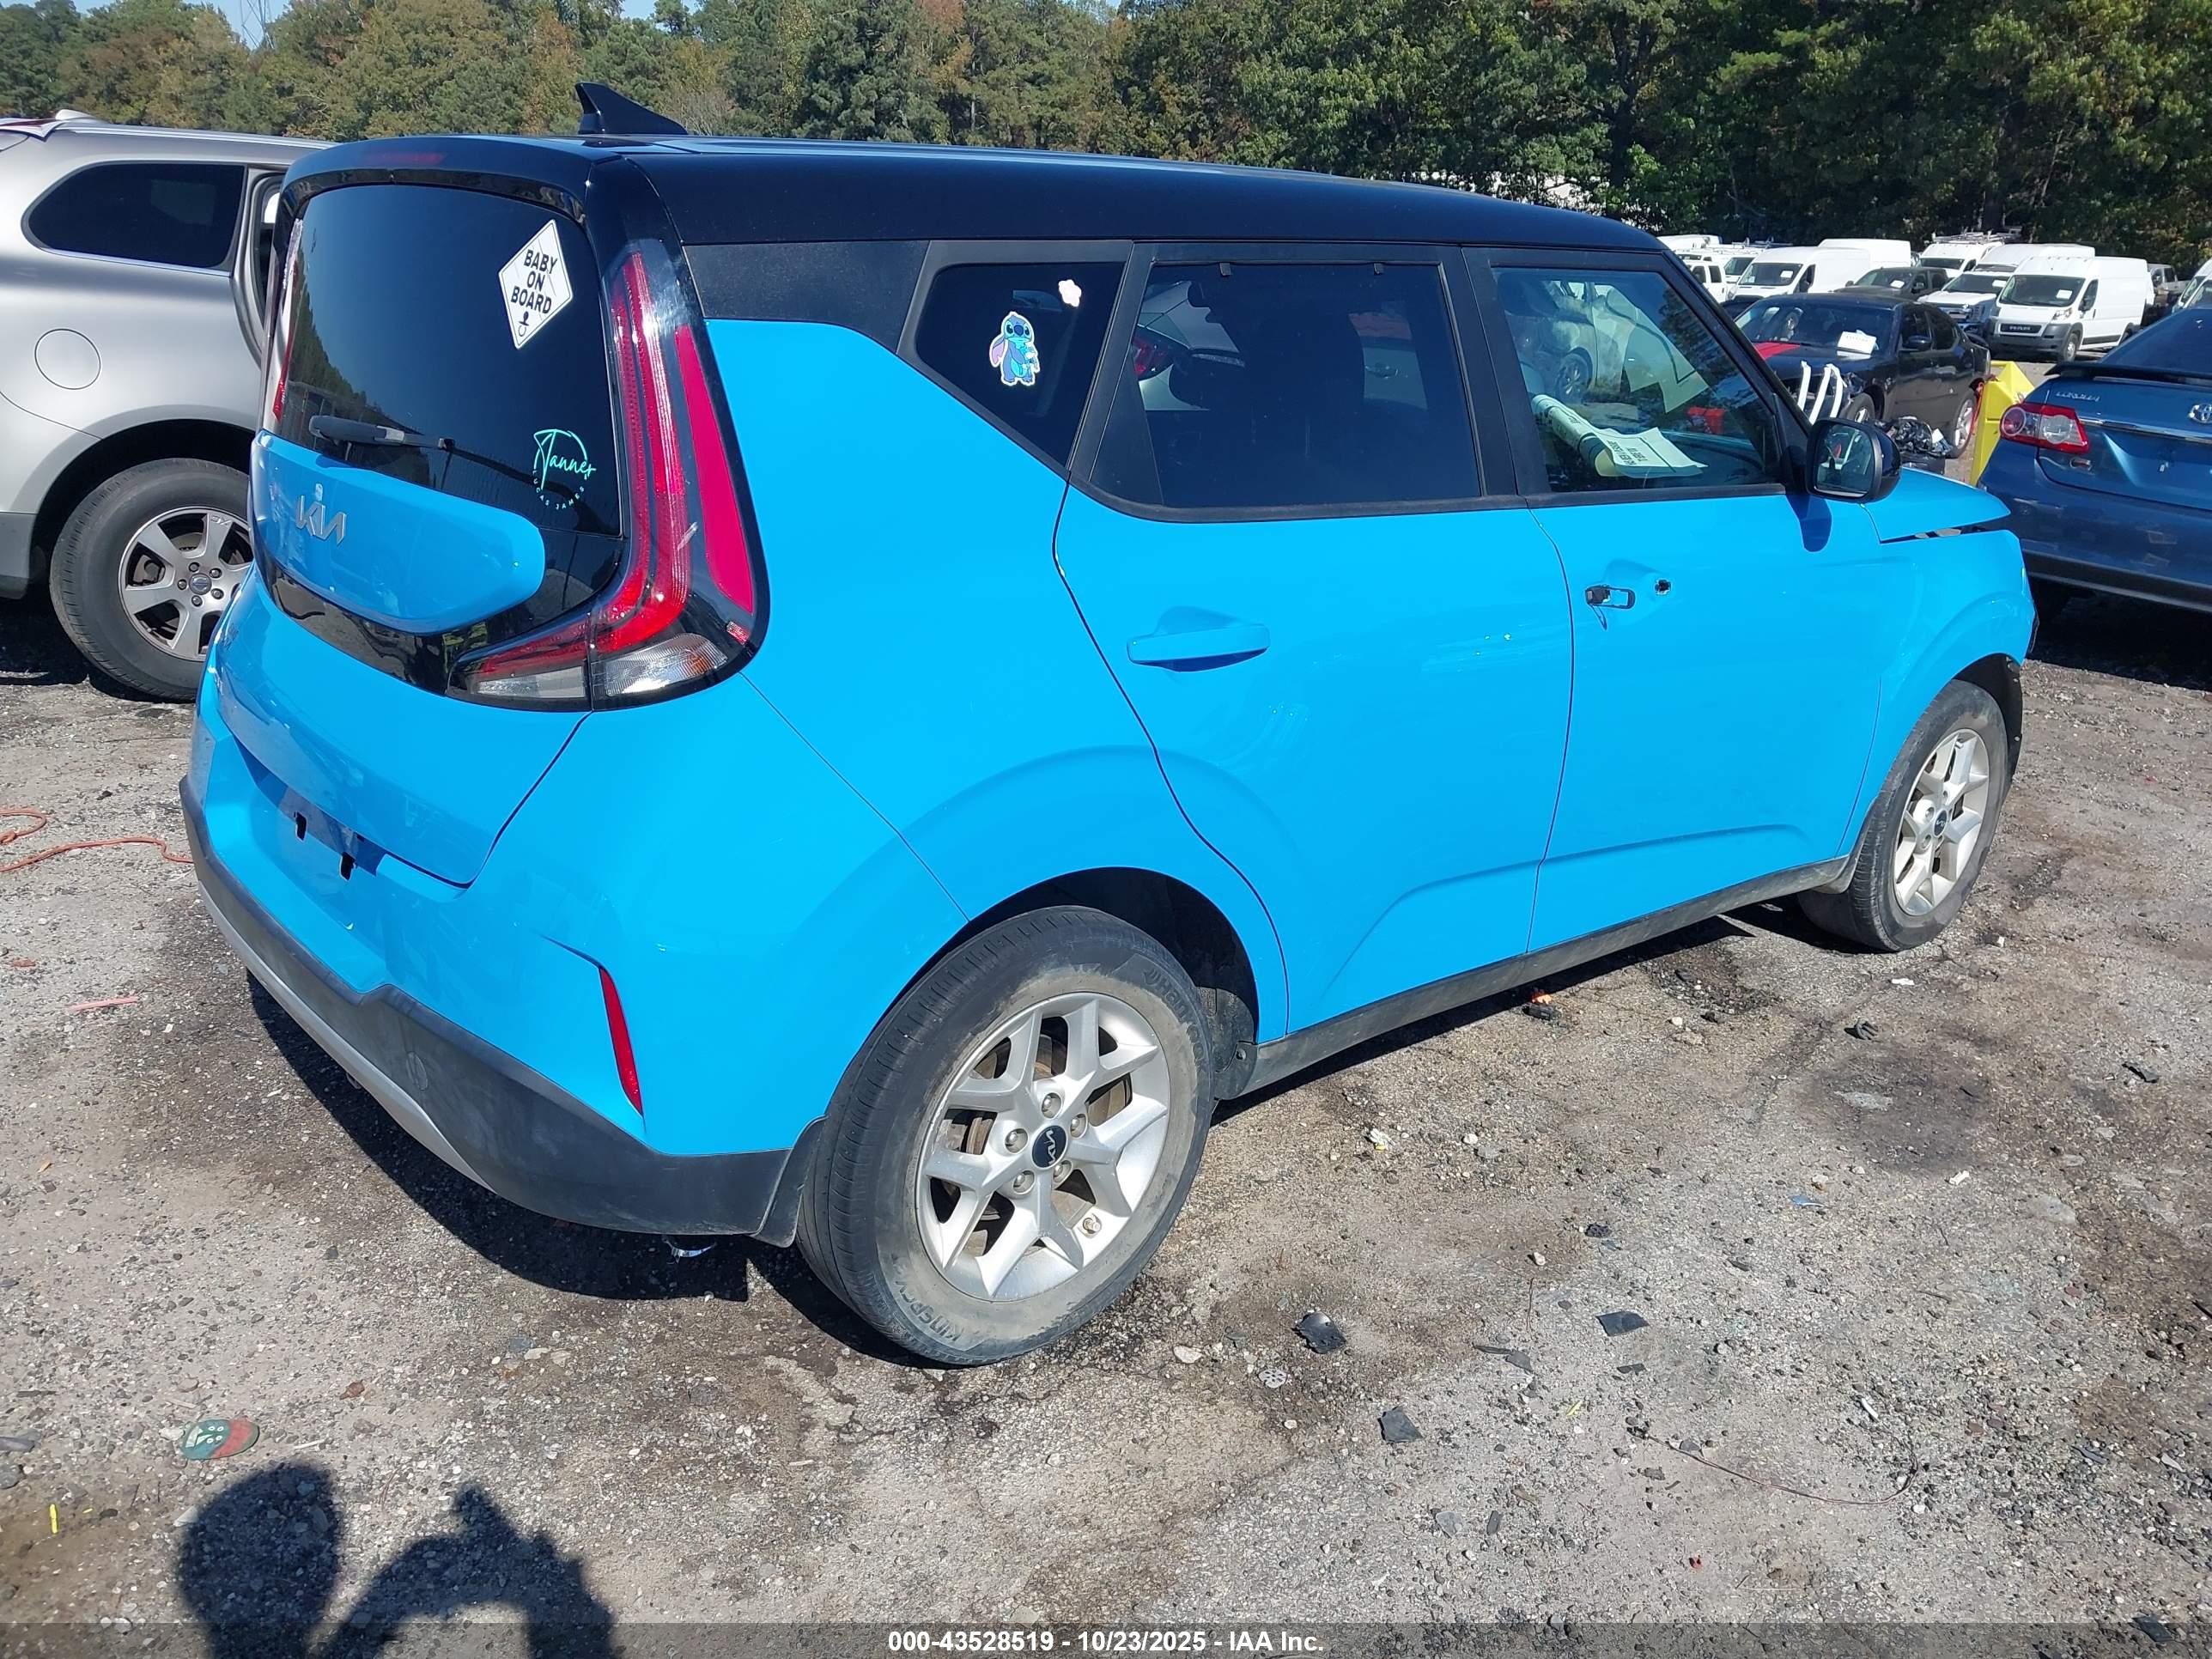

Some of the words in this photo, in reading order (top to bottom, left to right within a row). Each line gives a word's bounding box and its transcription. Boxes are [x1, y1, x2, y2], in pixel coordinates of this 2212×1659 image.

[523, 249, 558, 275] BABY
[526, 270, 545, 292] ON
[510, 285, 552, 314] BOARD
[533, 428, 597, 491] Tanner
[555, 485, 585, 511] JAMES
